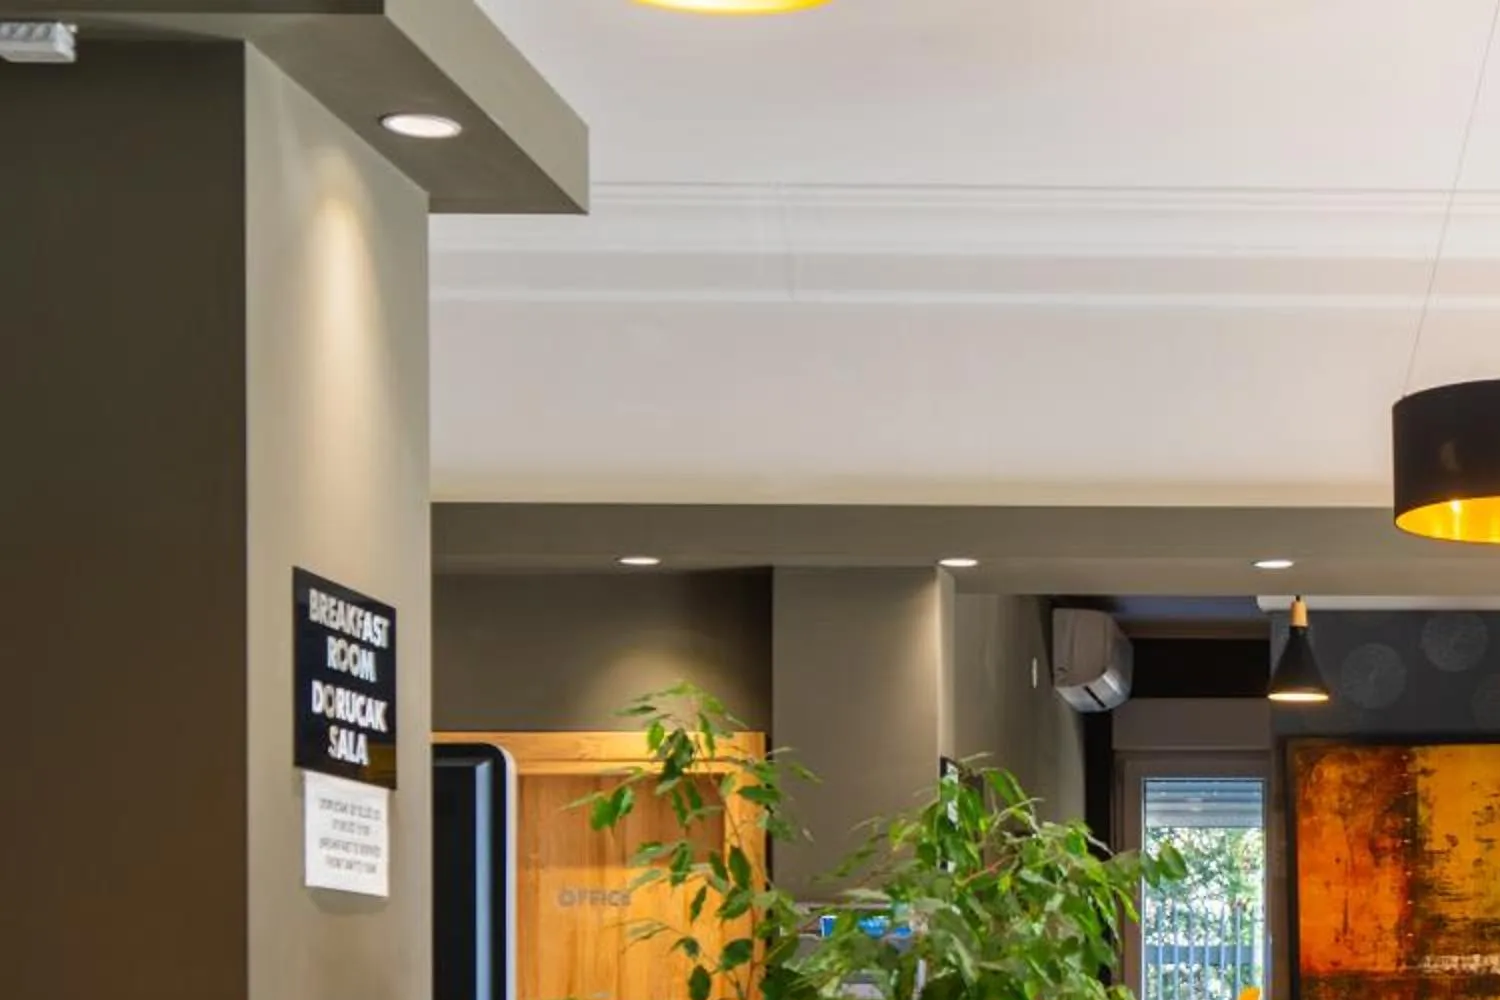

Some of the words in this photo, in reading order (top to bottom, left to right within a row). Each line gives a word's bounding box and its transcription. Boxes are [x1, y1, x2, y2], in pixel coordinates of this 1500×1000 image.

[309, 588, 389, 648] BREAKFAST
[327, 636, 377, 682] ROOM
[311, 680, 388, 732] DORUCAK
[328, 726, 369, 766] SALA
[558, 889, 631, 907] OFFICE
